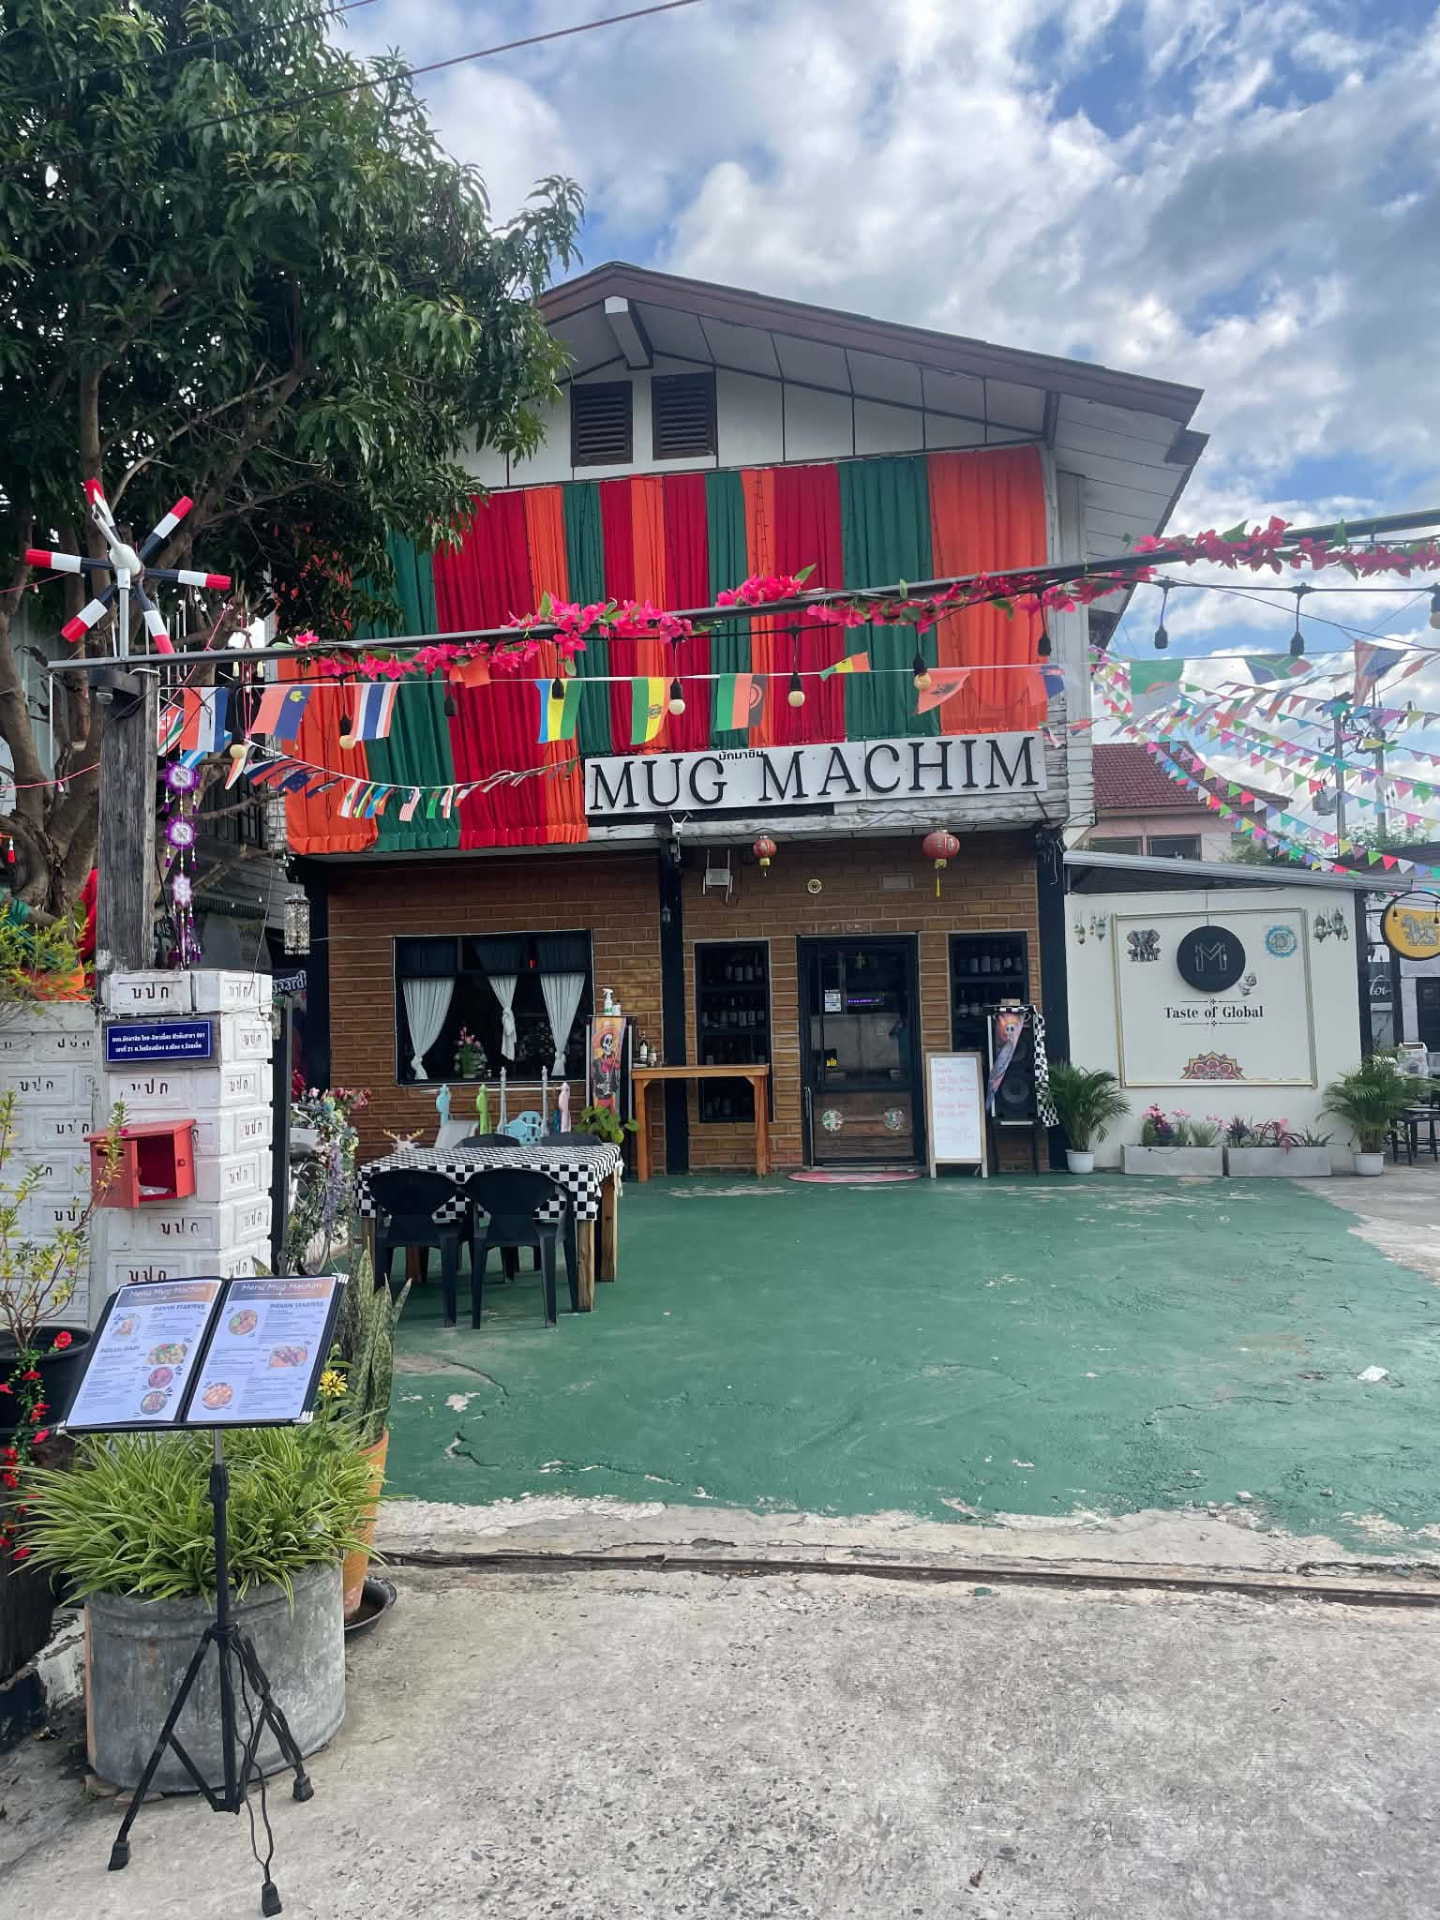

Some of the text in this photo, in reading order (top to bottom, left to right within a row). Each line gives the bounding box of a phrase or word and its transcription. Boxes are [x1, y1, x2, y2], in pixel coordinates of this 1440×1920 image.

[589, 736, 1040, 811] MUG MACHIM
[131, 982, 169, 999] บปก
[1164, 1005, 1264, 1019] Taste of Global
